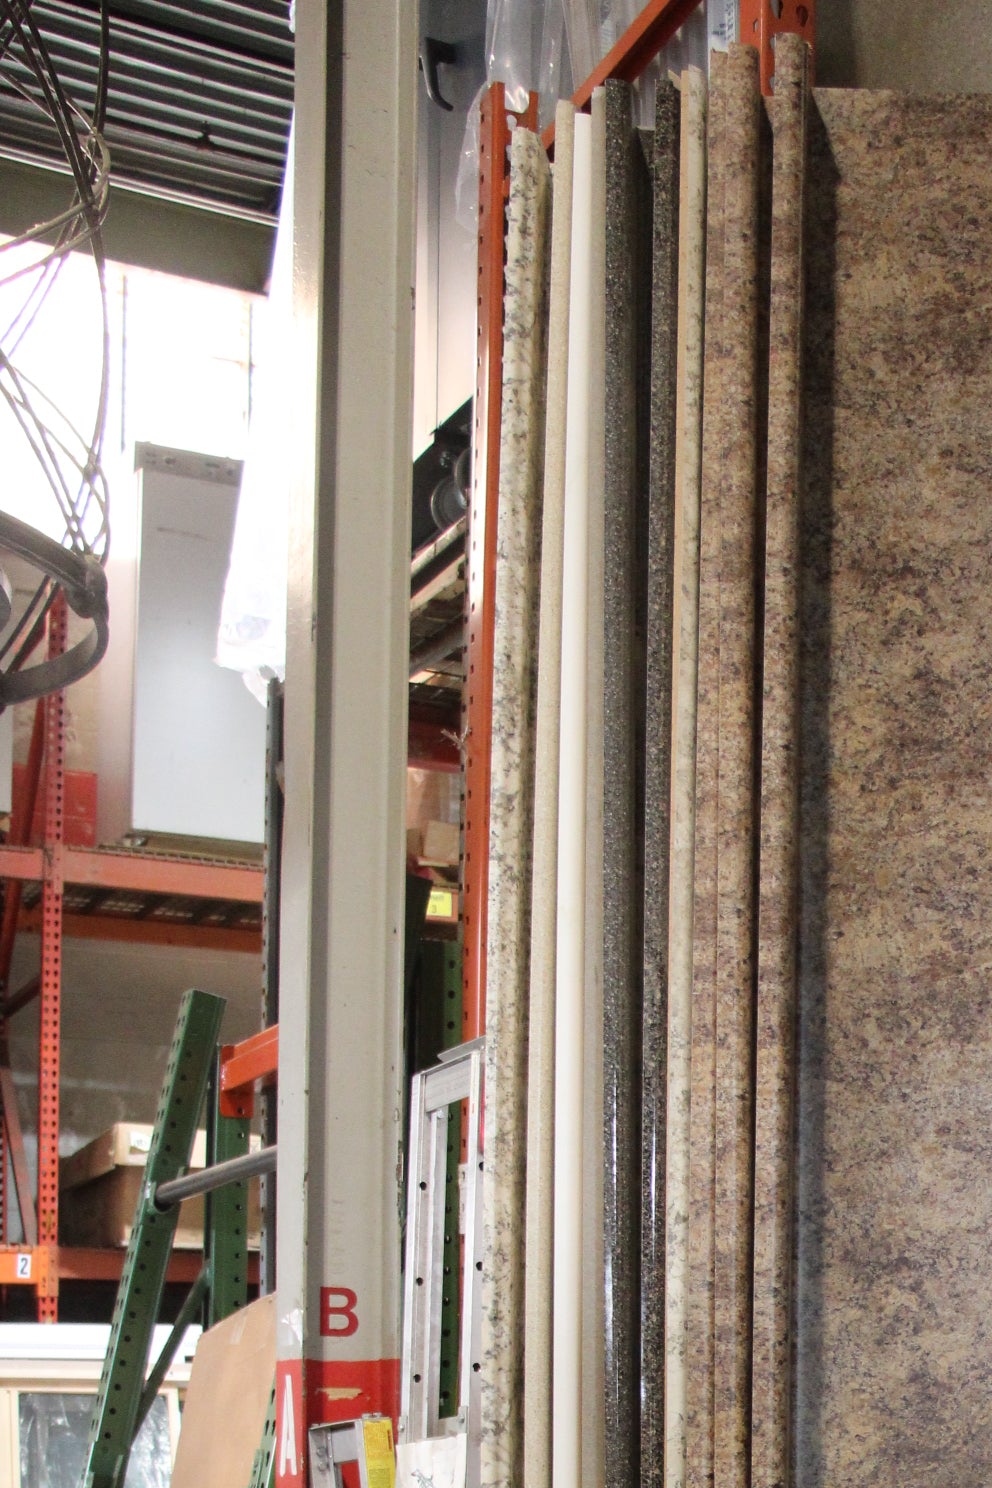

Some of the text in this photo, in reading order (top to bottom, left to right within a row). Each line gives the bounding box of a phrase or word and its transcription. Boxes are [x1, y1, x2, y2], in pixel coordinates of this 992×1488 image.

[20, 1257, 28, 1275] 2
[320, 1286, 359, 1337] B
[279, 1374, 298, 1478] A
